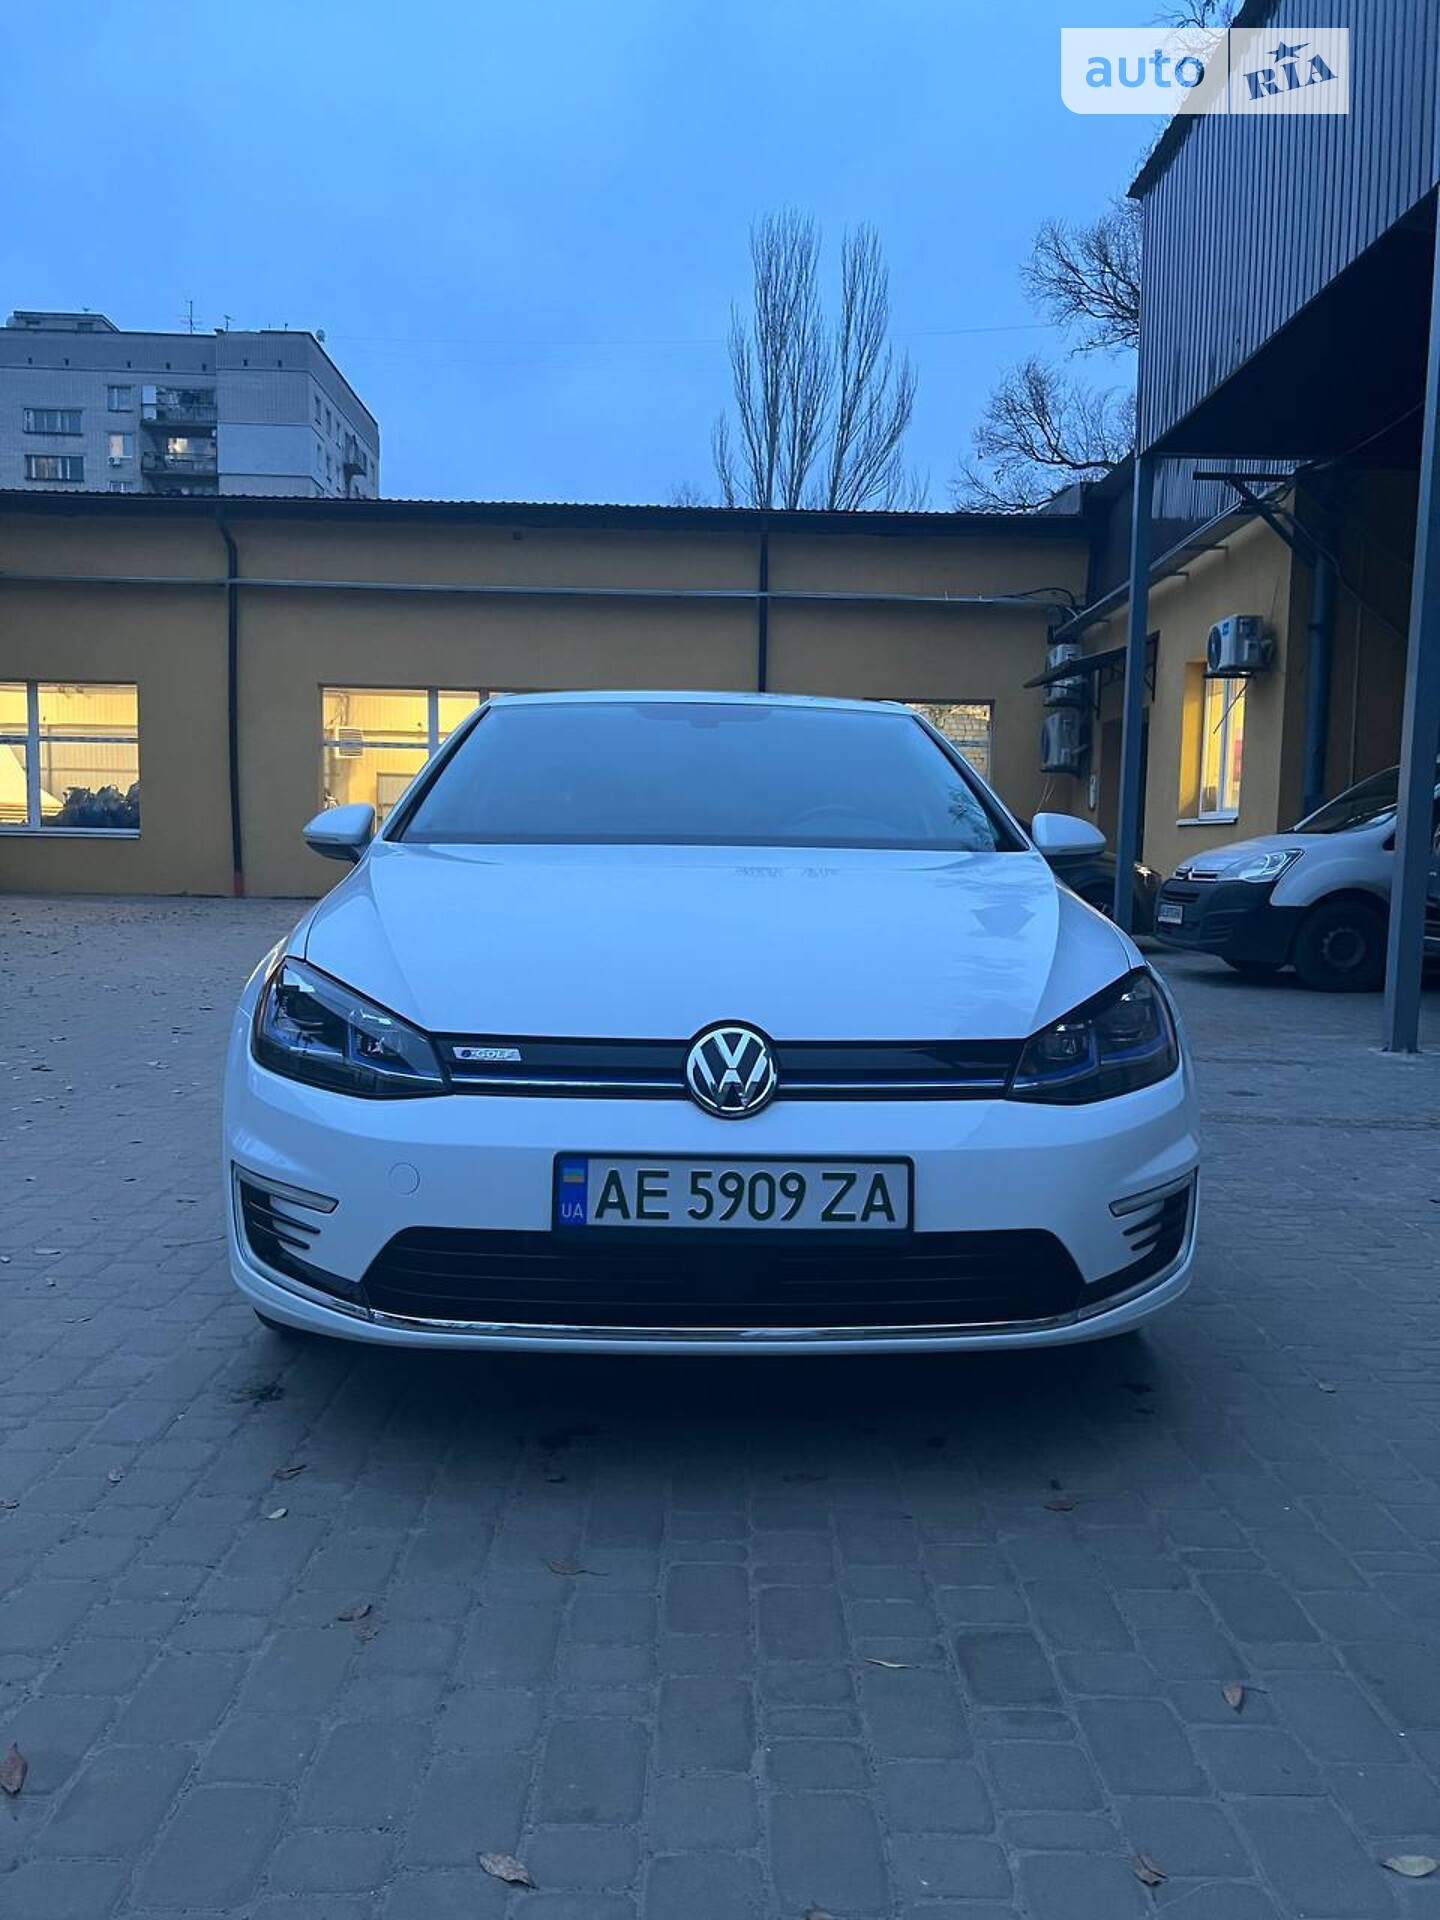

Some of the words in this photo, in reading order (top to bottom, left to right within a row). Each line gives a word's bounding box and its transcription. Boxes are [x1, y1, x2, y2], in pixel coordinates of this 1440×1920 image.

[561, 1202, 584, 1219] UA
[594, 1169, 671, 1221] AE
[687, 1170, 807, 1222] 5909
[820, 1171, 897, 1223] ZA
